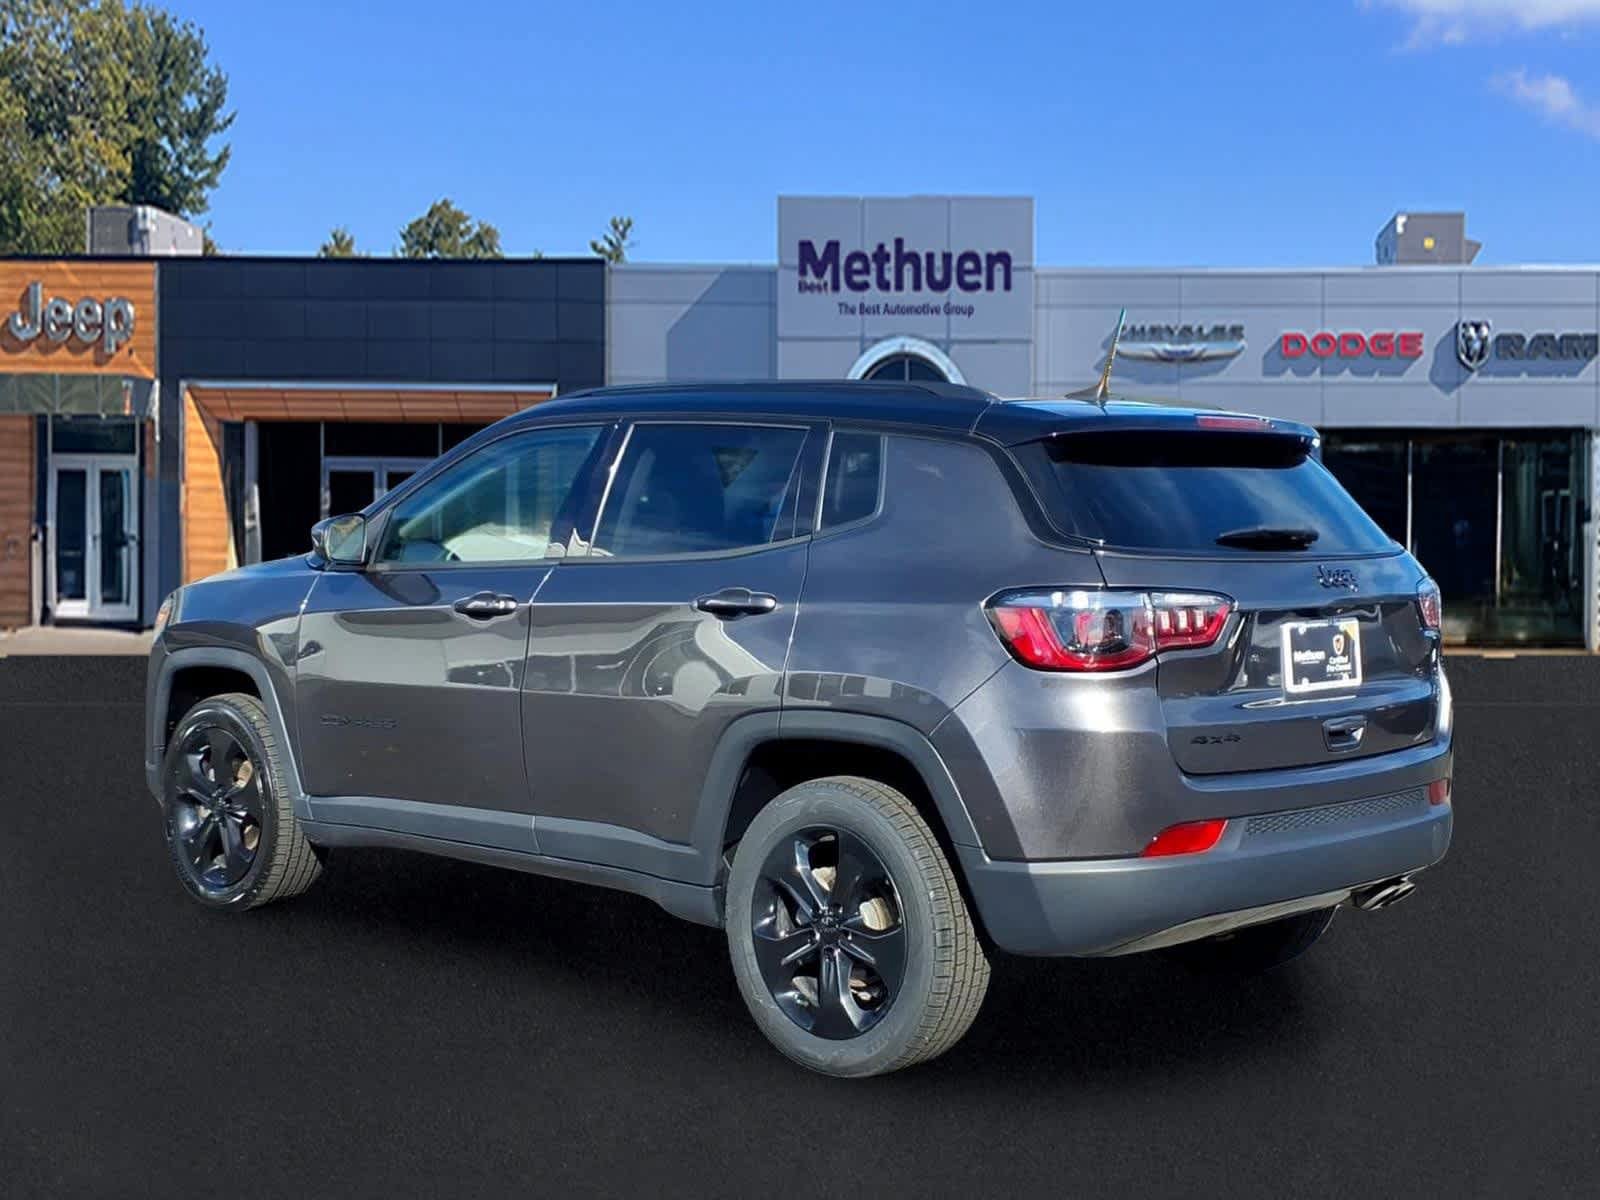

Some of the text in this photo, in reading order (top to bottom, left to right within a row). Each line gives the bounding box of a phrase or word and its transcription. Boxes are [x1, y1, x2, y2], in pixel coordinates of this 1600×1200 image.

[797, 237, 1013, 293] Methuen
[798, 281, 829, 294] Best
[8, 280, 135, 353] Jeep
[838, 301, 975, 318] The Best Automotive Group
[1281, 332, 1424, 358] DODGE
[1494, 333, 1599, 360] RAM
